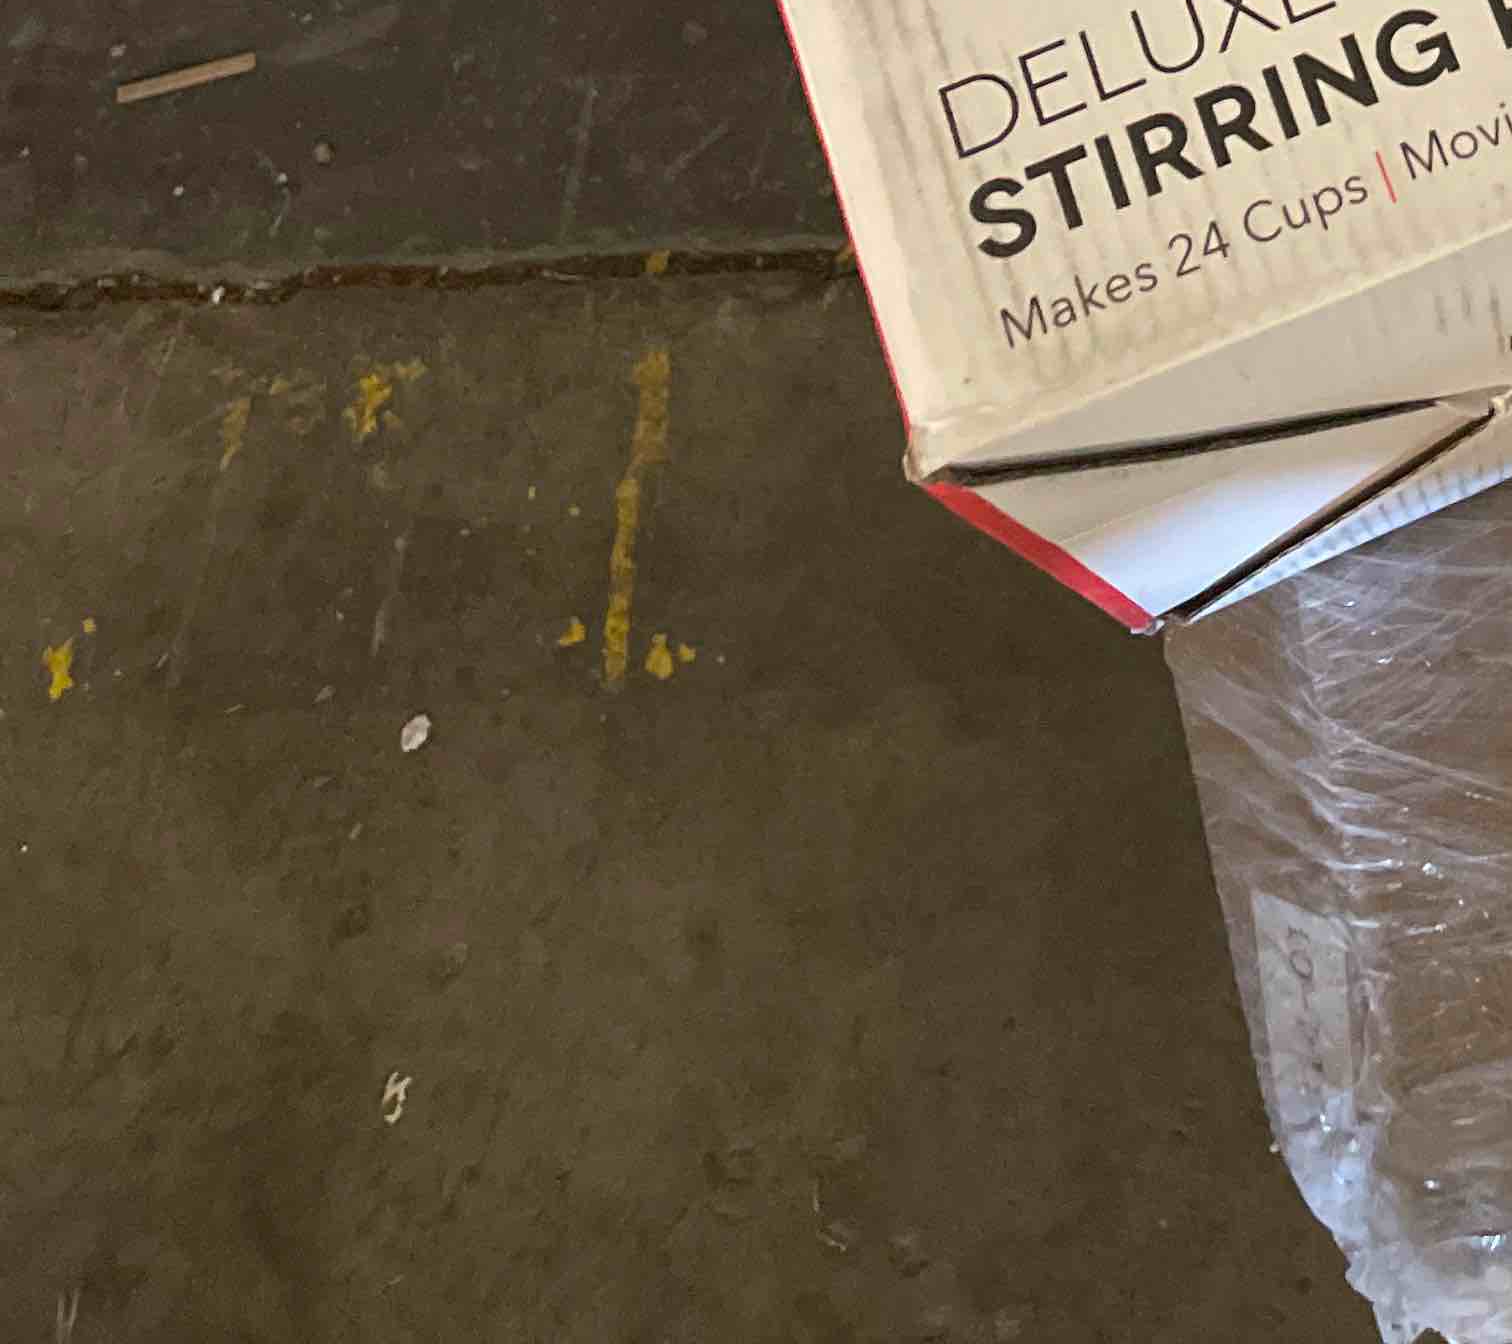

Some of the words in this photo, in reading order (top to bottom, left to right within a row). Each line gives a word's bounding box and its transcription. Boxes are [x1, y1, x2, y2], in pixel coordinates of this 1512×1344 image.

[967, 6, 1461, 261] STIRRING
[999, 257, 1159, 350] Makes
[1167, 220, 1232, 278] 24
[1242, 172, 1370, 246] Cups
